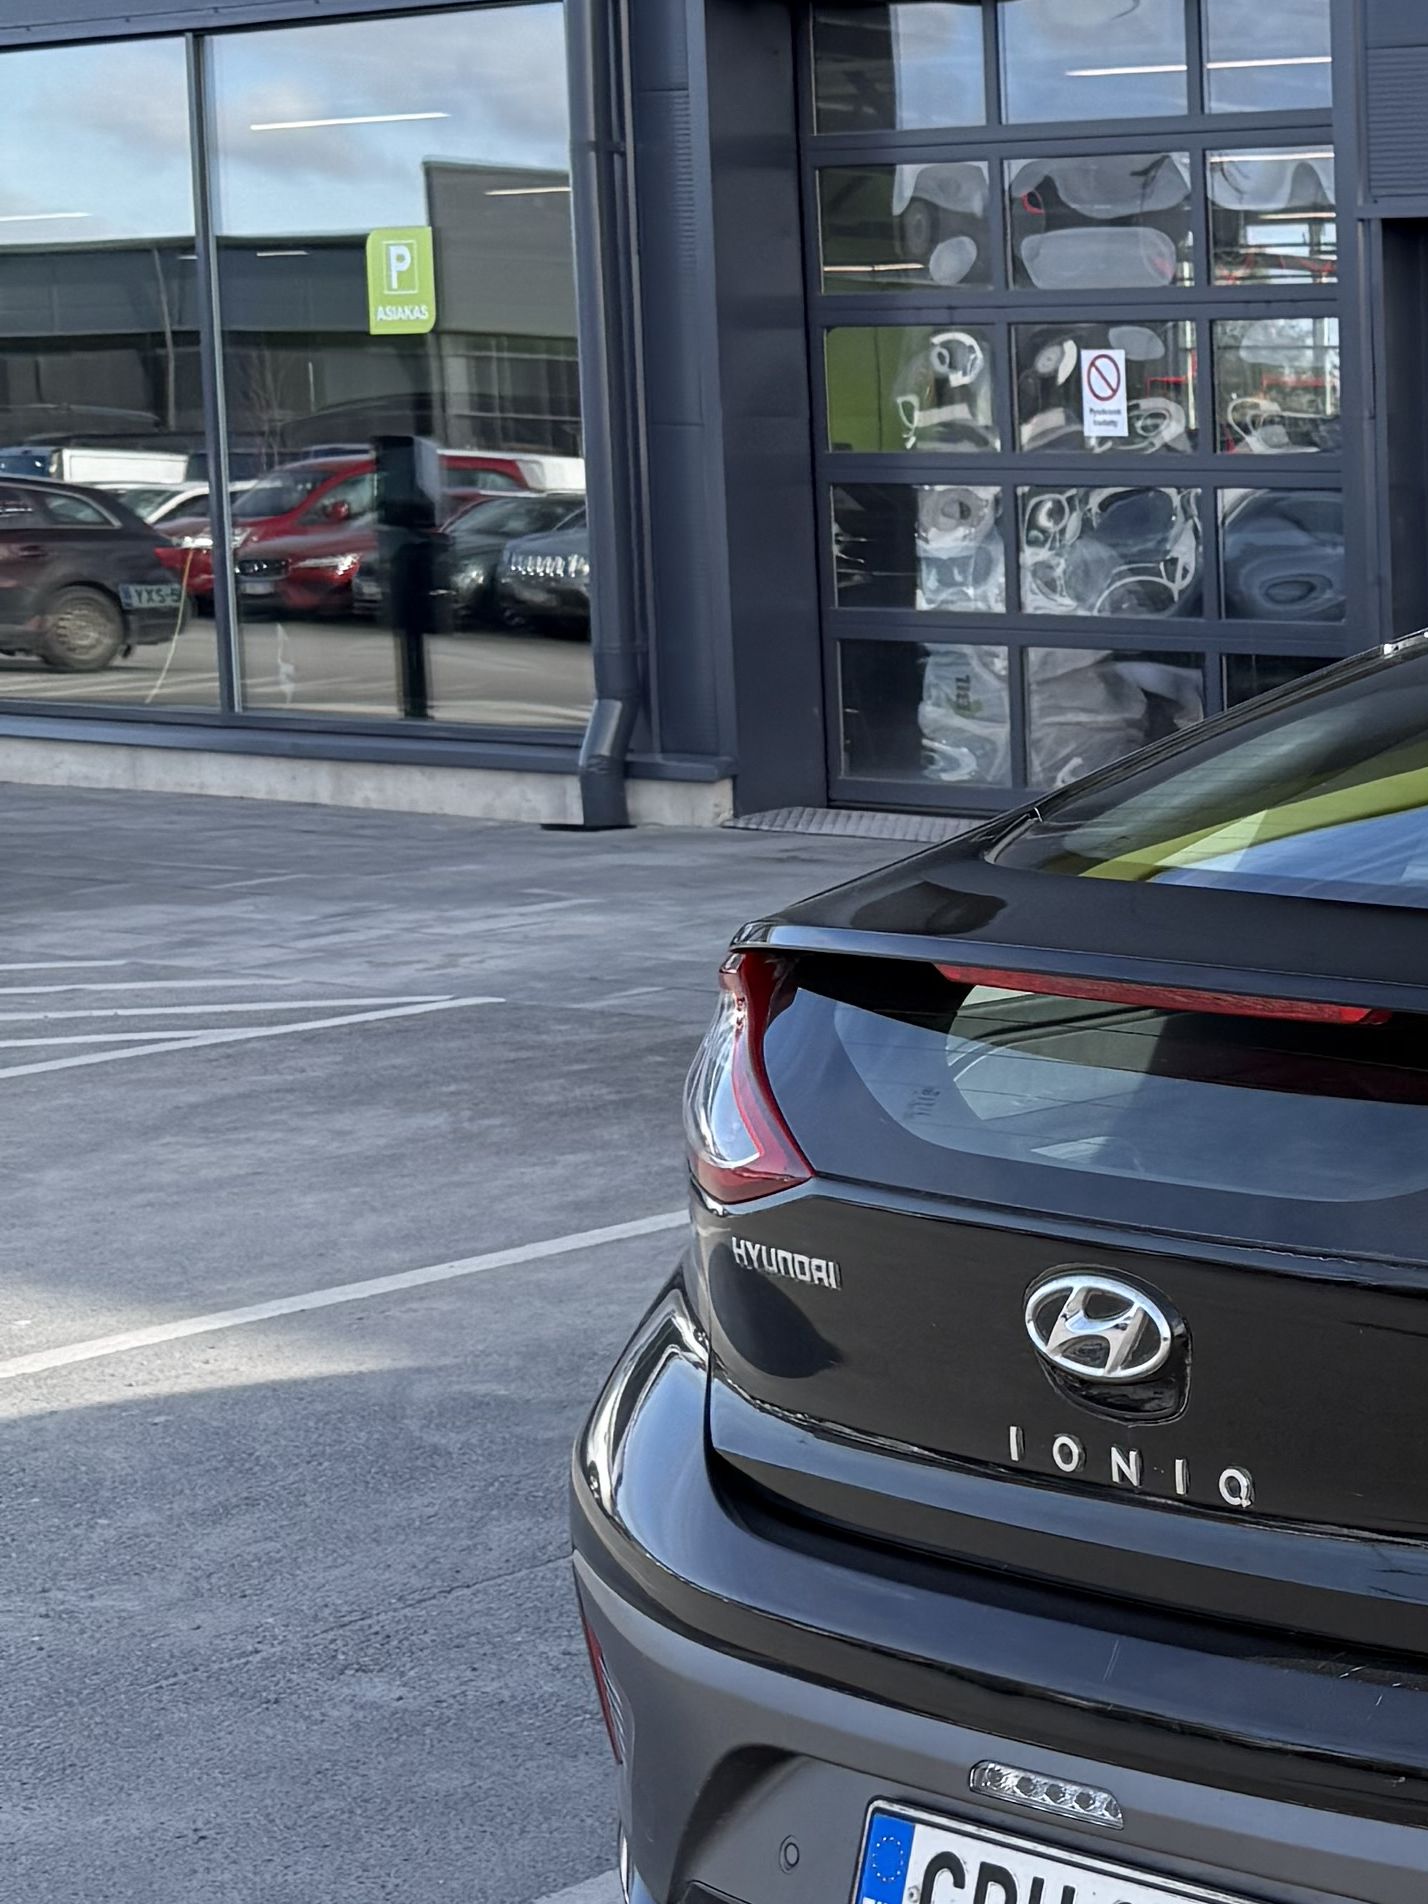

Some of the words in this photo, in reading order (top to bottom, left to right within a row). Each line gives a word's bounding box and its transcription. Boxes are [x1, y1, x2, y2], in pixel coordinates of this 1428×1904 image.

[391, 245, 411, 289] P
[377, 305, 429, 321] ASIAKAS
[730, 1236, 842, 1292] HYUNDAI
[1008, 1425, 1258, 1510] IONIQ
